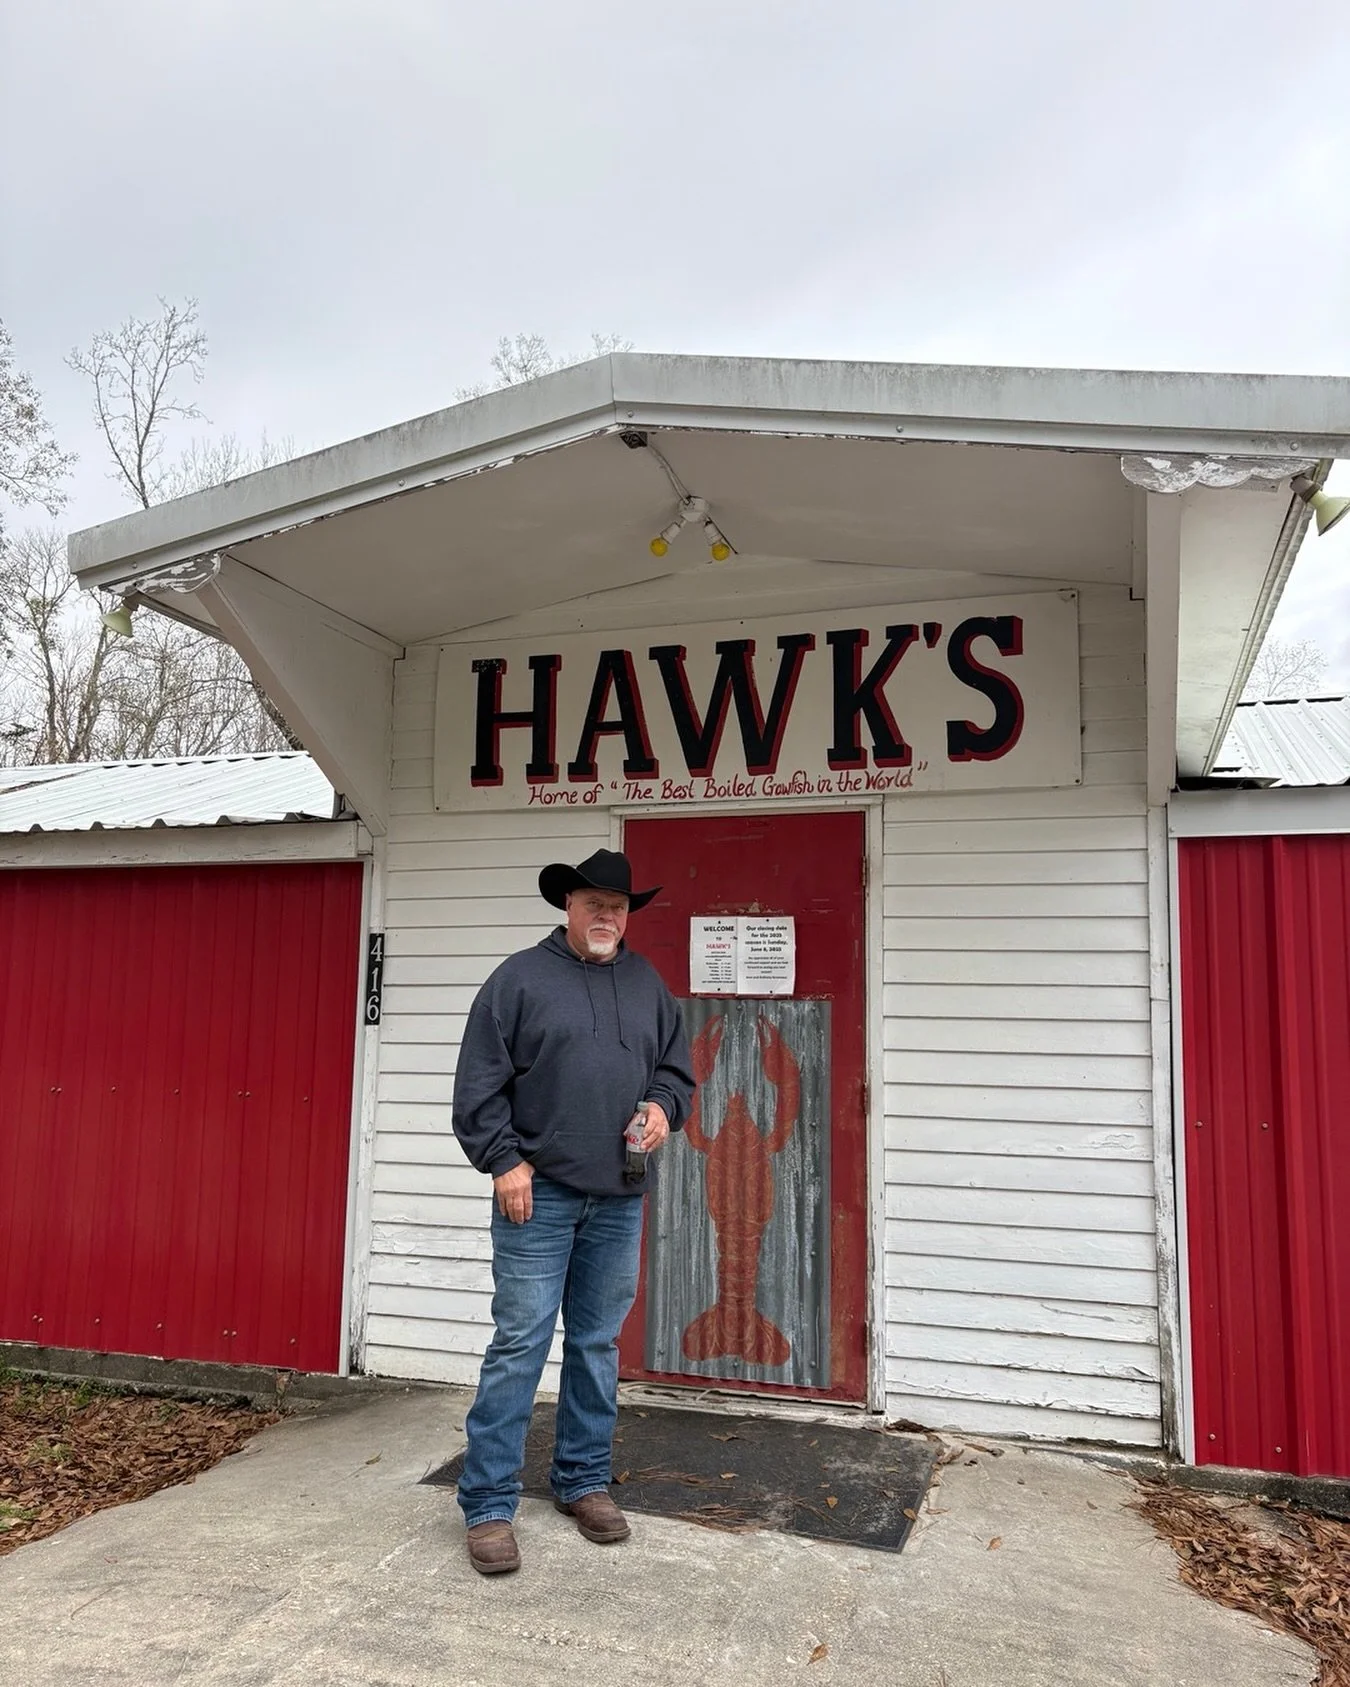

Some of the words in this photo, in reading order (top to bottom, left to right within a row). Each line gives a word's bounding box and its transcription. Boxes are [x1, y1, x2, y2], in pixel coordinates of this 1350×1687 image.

[471, 615, 1025, 787] HAWK'S
[528, 785, 577, 805] Home
[582, 784, 604, 804] of
[661, 779, 694, 799] Best
[703, 775, 756, 798] Boiled
[817, 775, 833, 794] in
[836, 769, 862, 792] the
[367, 937, 382, 1020] 416
